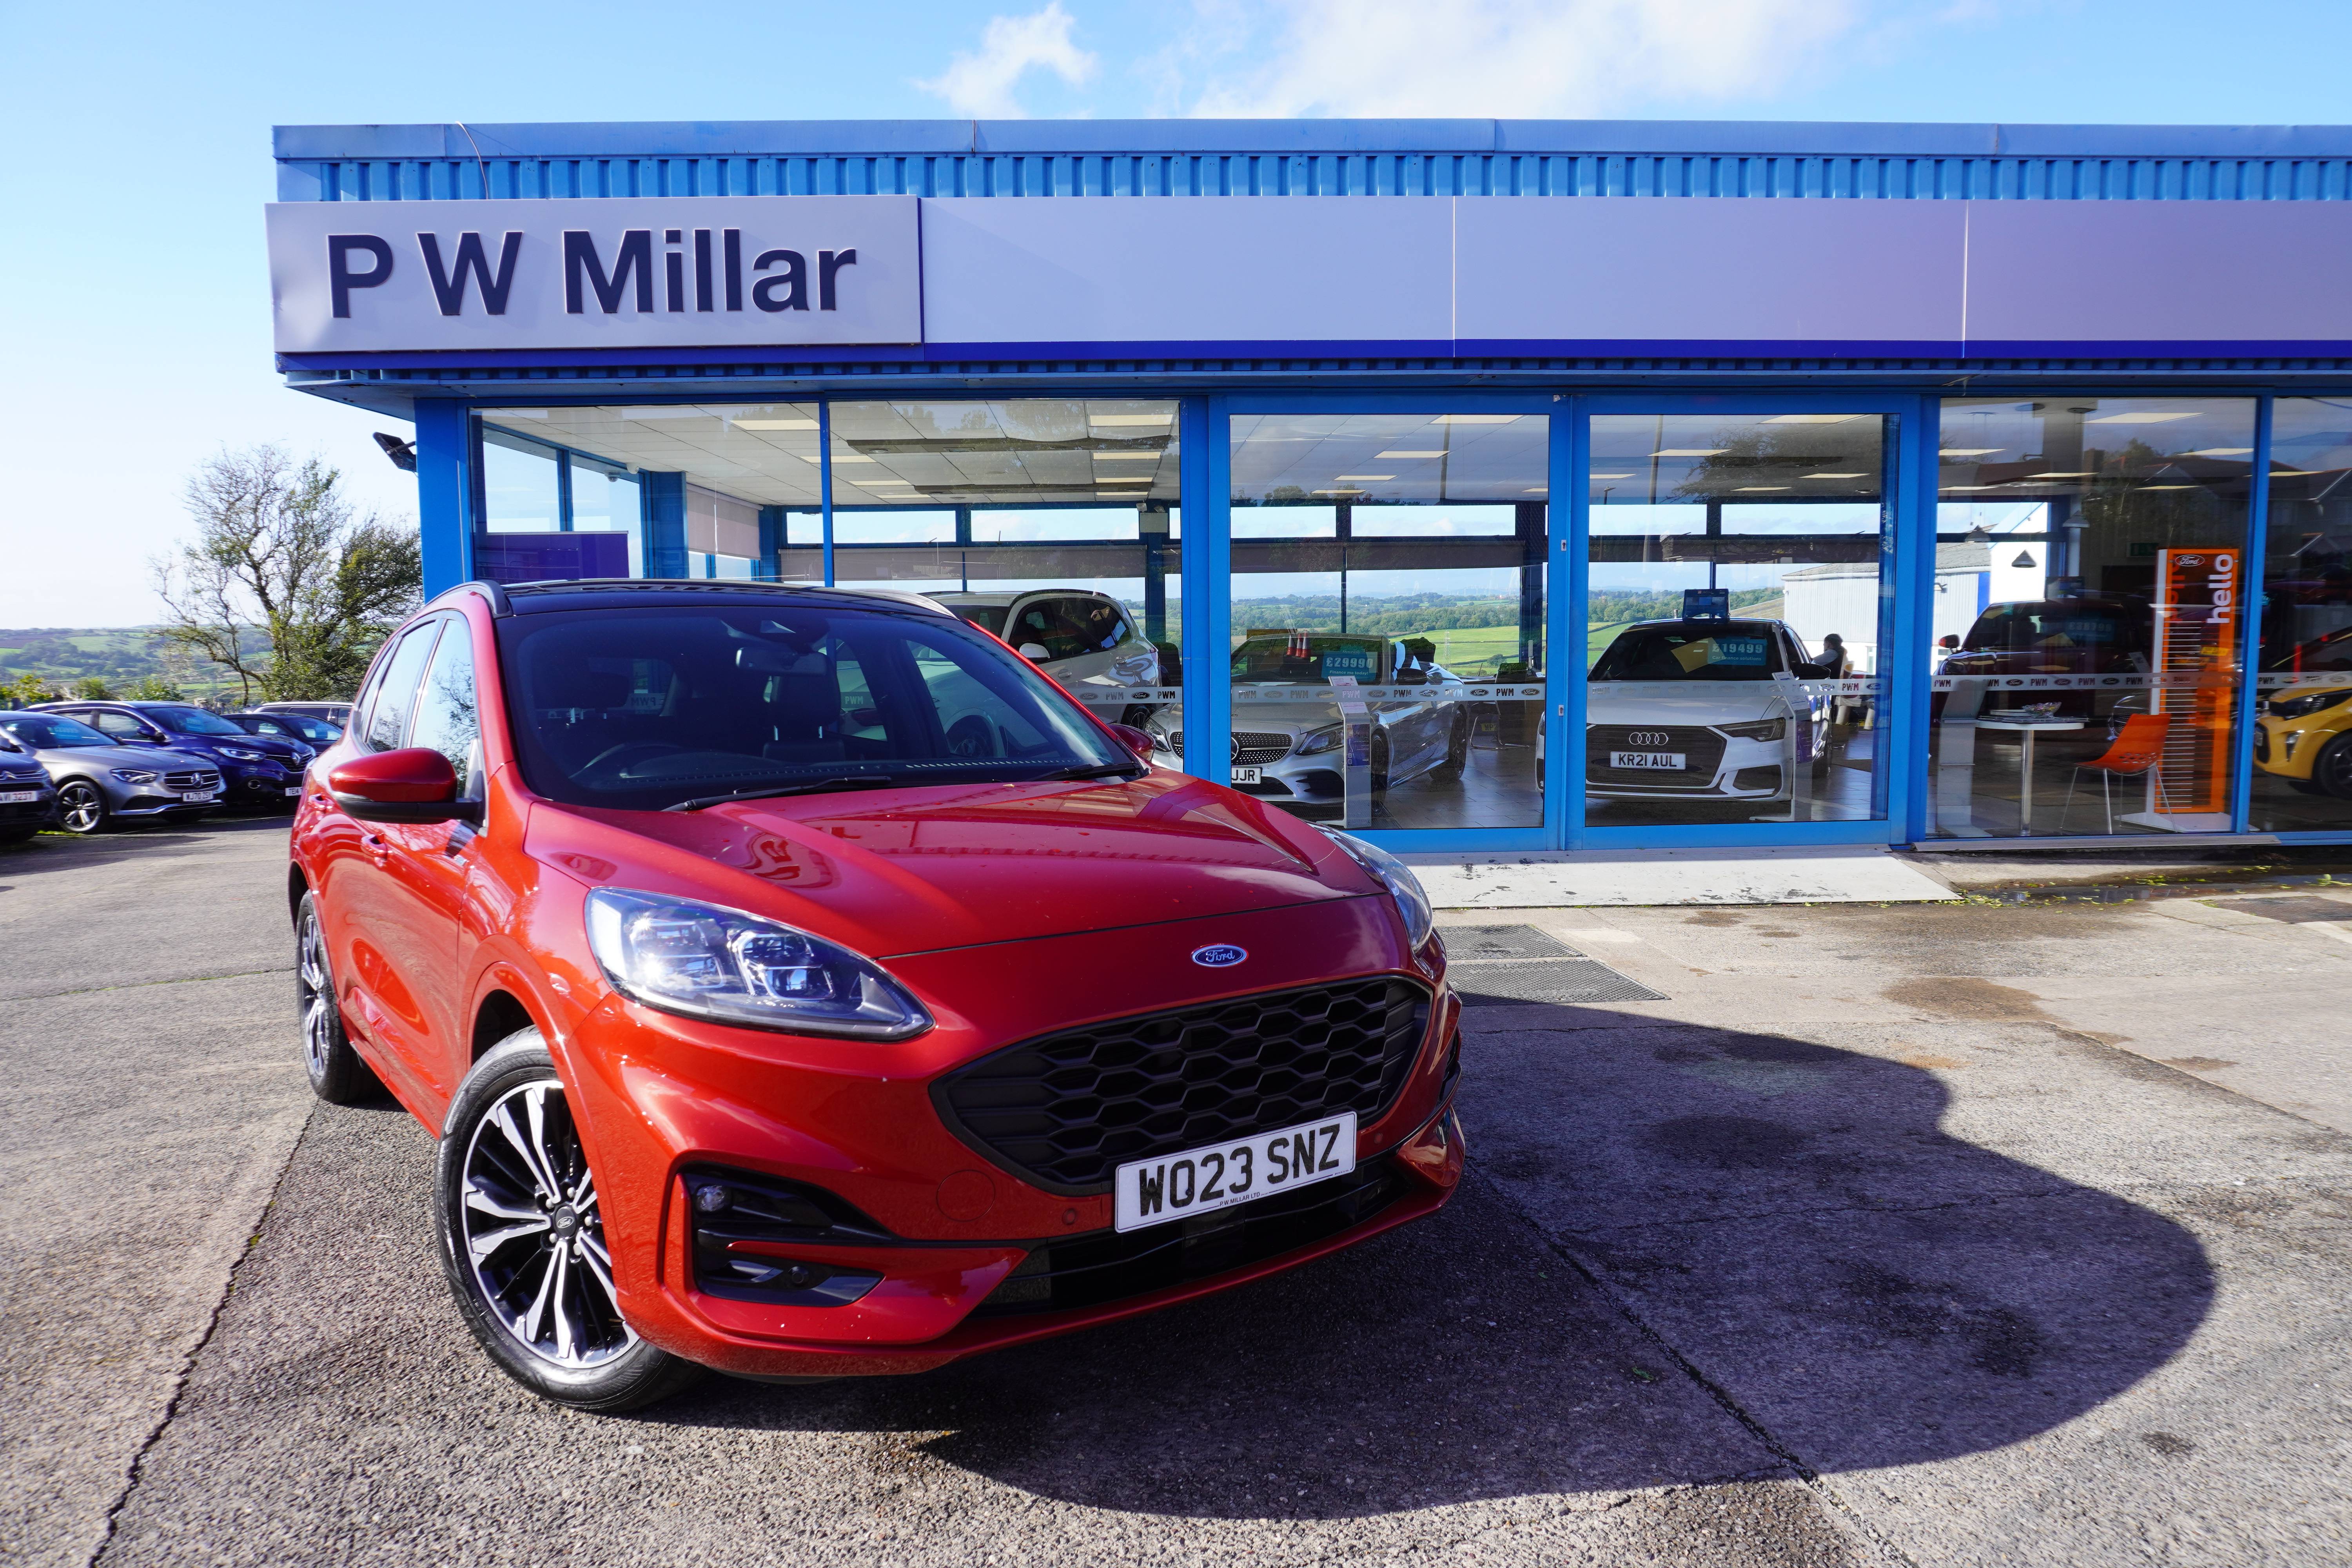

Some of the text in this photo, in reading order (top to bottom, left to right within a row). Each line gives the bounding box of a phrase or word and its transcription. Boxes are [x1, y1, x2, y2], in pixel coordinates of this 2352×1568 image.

[327, 229, 857, 318] P W Millar
[2180, 556, 2200, 564] Ford
[2207, 554, 2234, 624] hello
[1712, 644, 1763, 653] £19499
[1326, 657, 1373, 668] £29990
[1106, 691, 1124, 700] PWM
[1158, 691, 1175, 699] PWM
[1238, 690, 1257, 699] PWM
[1290, 690, 1308, 699] PWM
[1394, 690, 1411, 698] PWM
[845, 696, 863, 704] PWM
[1619, 753, 1677, 767] KR21 AUL
[1267, 1123, 1340, 1184] SNZ
